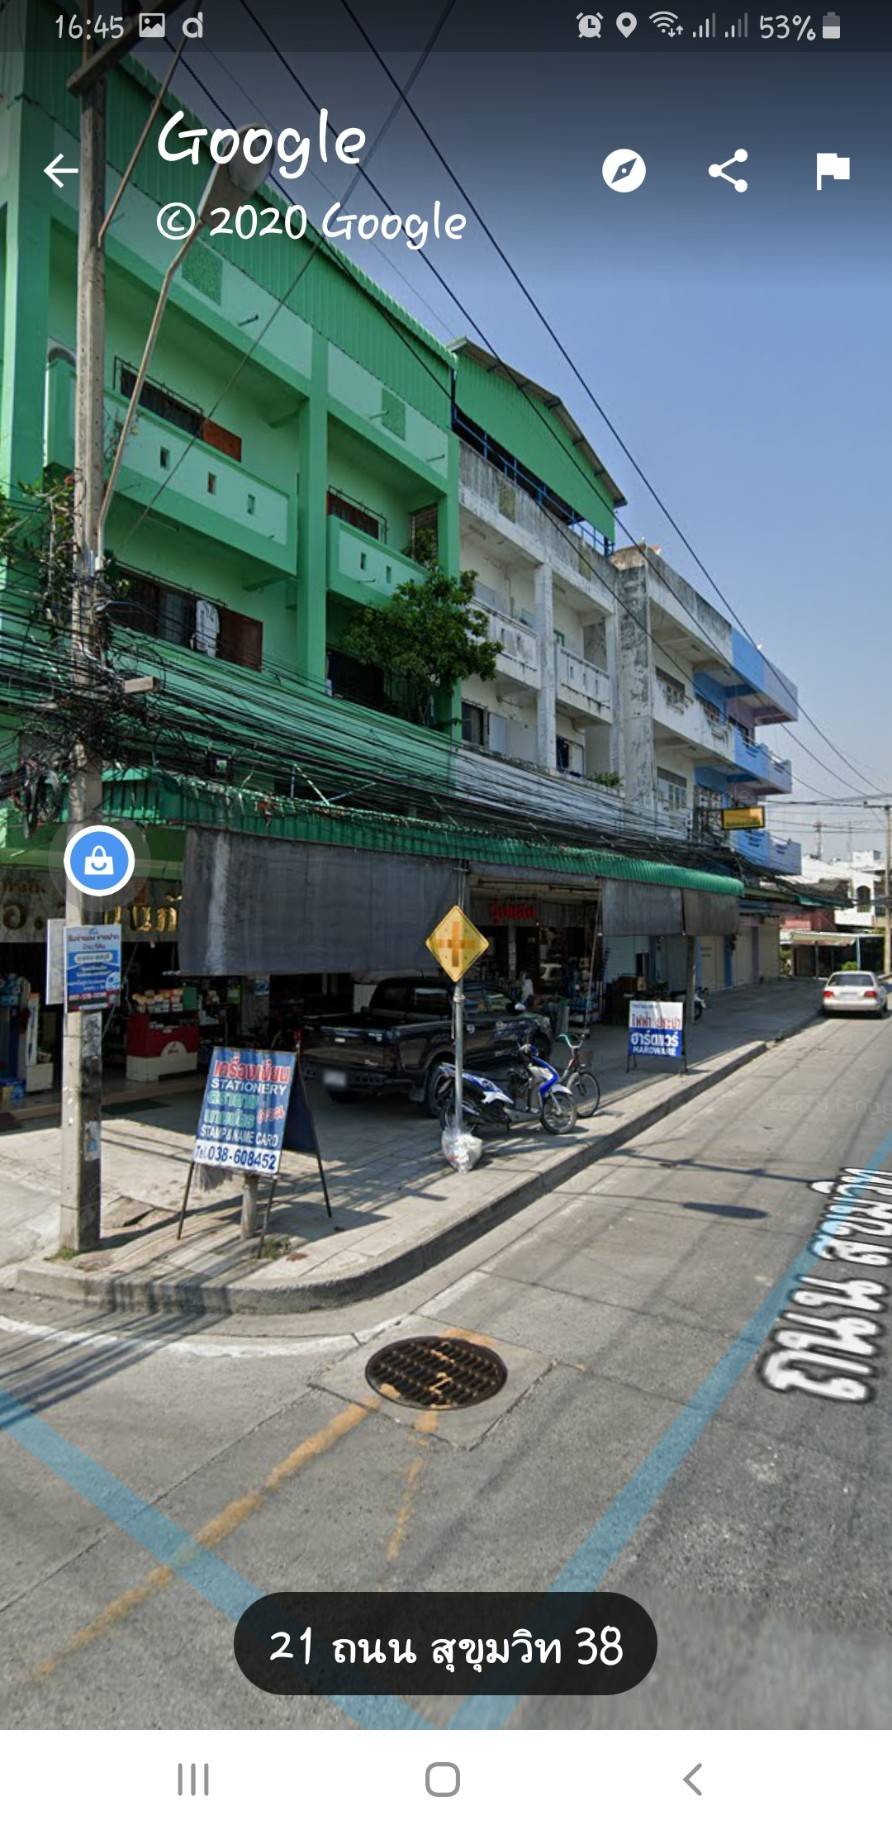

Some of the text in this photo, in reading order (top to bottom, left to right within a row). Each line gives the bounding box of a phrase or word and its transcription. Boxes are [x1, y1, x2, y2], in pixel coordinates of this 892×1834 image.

[211, 1079, 287, 1095] STATIONERY
[256, 1132, 278, 1147] CARD
[208, 1146, 277, 1170] 038-608452
